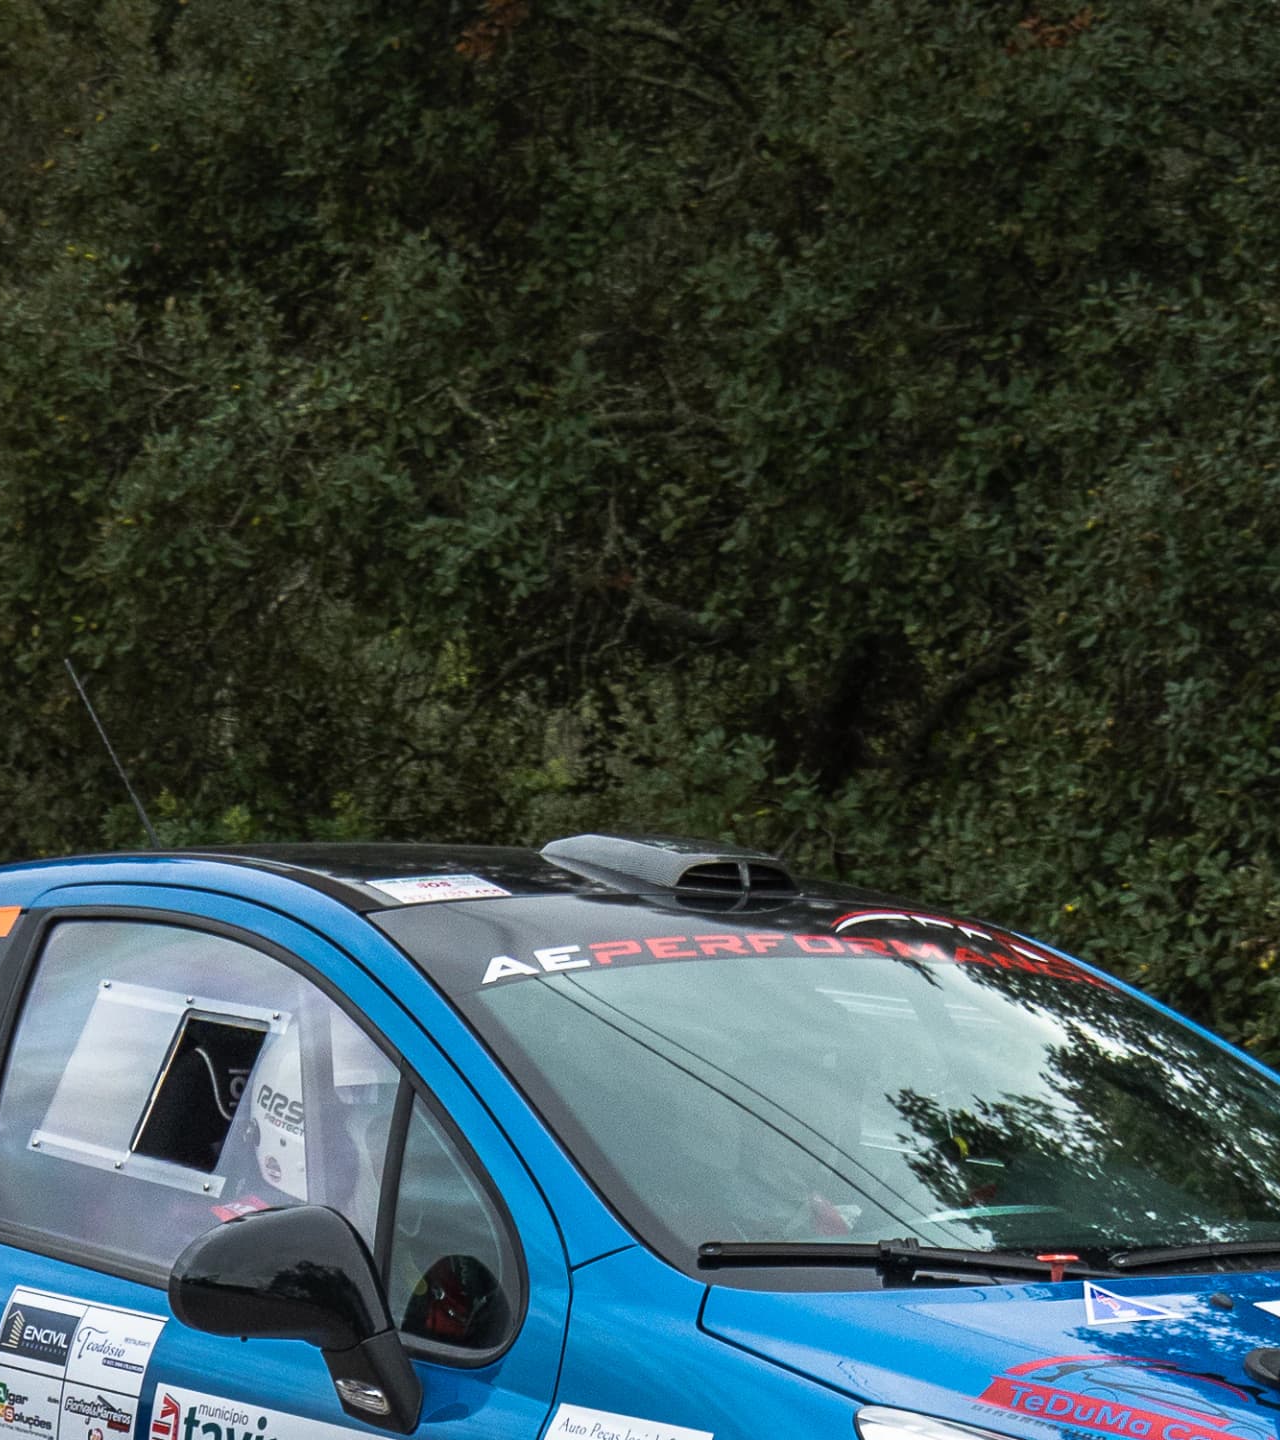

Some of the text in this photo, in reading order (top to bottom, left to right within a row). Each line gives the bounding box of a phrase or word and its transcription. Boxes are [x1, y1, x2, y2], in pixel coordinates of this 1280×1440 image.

[23, 1324, 68, 1349] ENCIVIL
[198, 1403, 250, 1426] município
[558, 1417, 587, 1436] Auto
